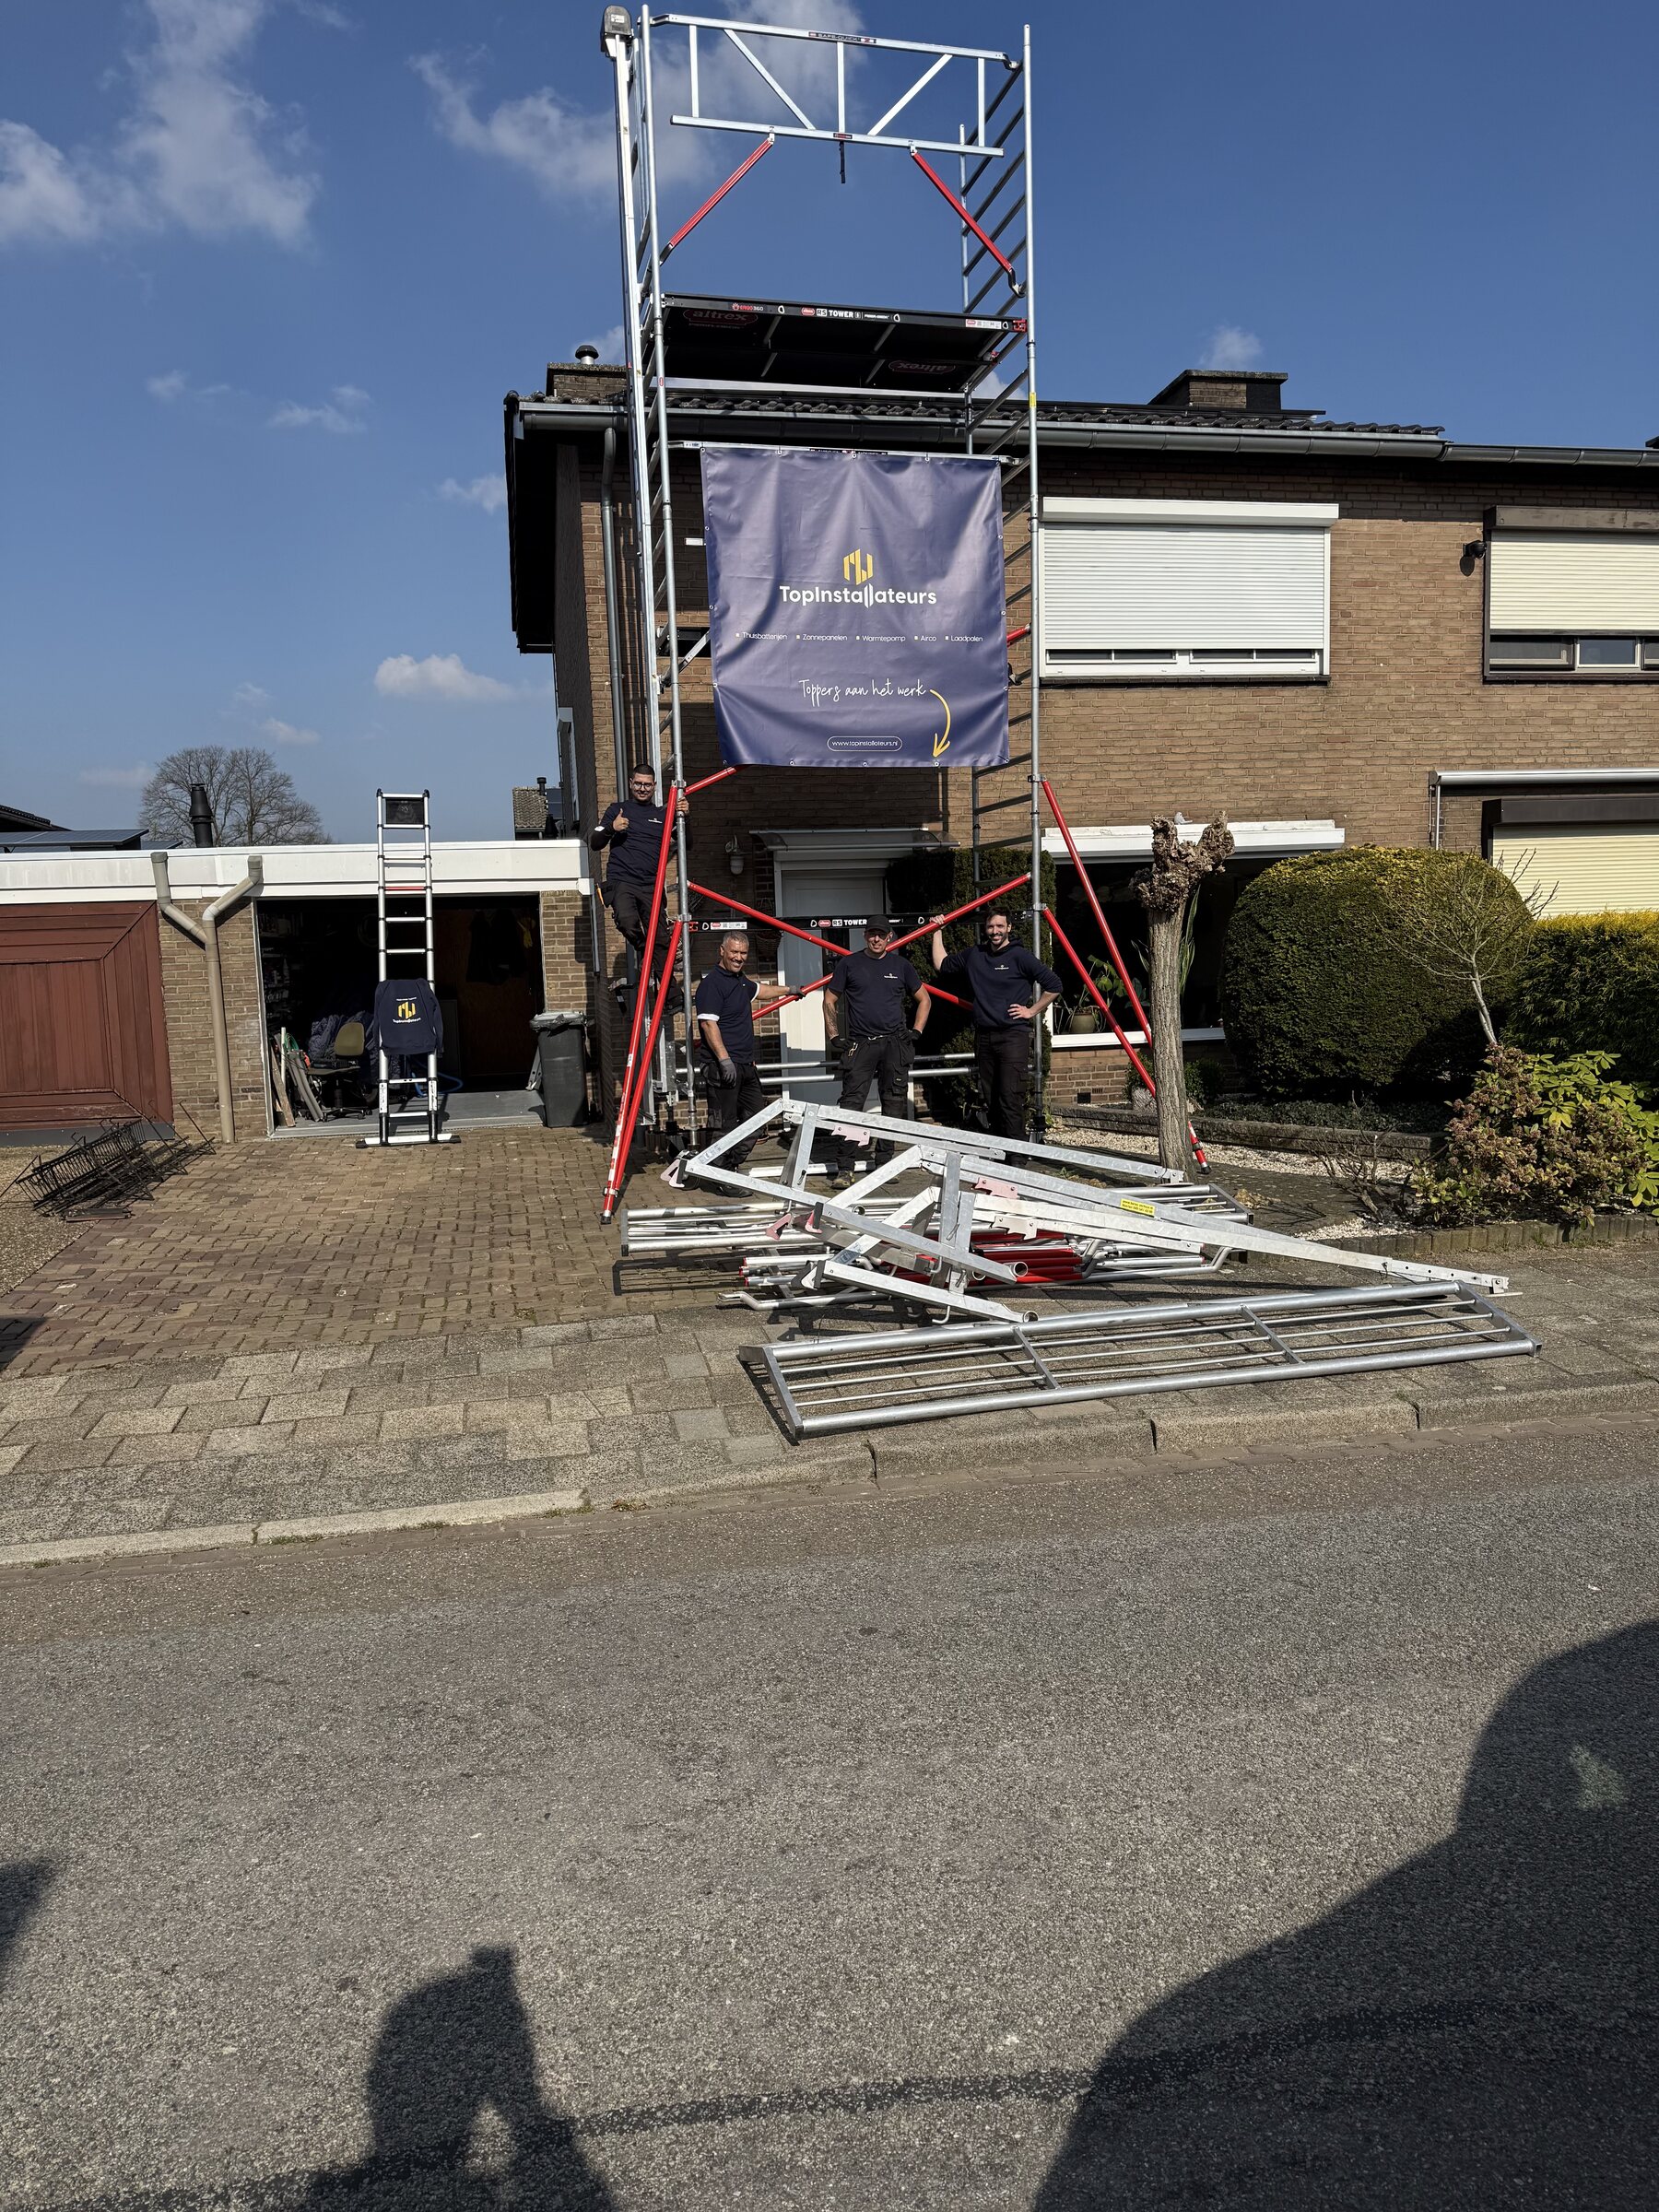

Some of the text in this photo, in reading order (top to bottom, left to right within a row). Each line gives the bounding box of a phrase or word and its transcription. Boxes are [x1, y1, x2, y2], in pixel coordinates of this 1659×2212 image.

[692, 311, 748, 321] altrex
[829, 309, 854, 319] TOWER
[779, 582, 937, 609] TopInstallateurs
[802, 633, 848, 642] Zonnepanelen
[862, 635, 906, 643] Warmtepomp
[950, 635, 983, 643] Laadpalen
[798, 677, 926, 707] Toppers aan het werk
[843, 918, 867, 926] TOWER
